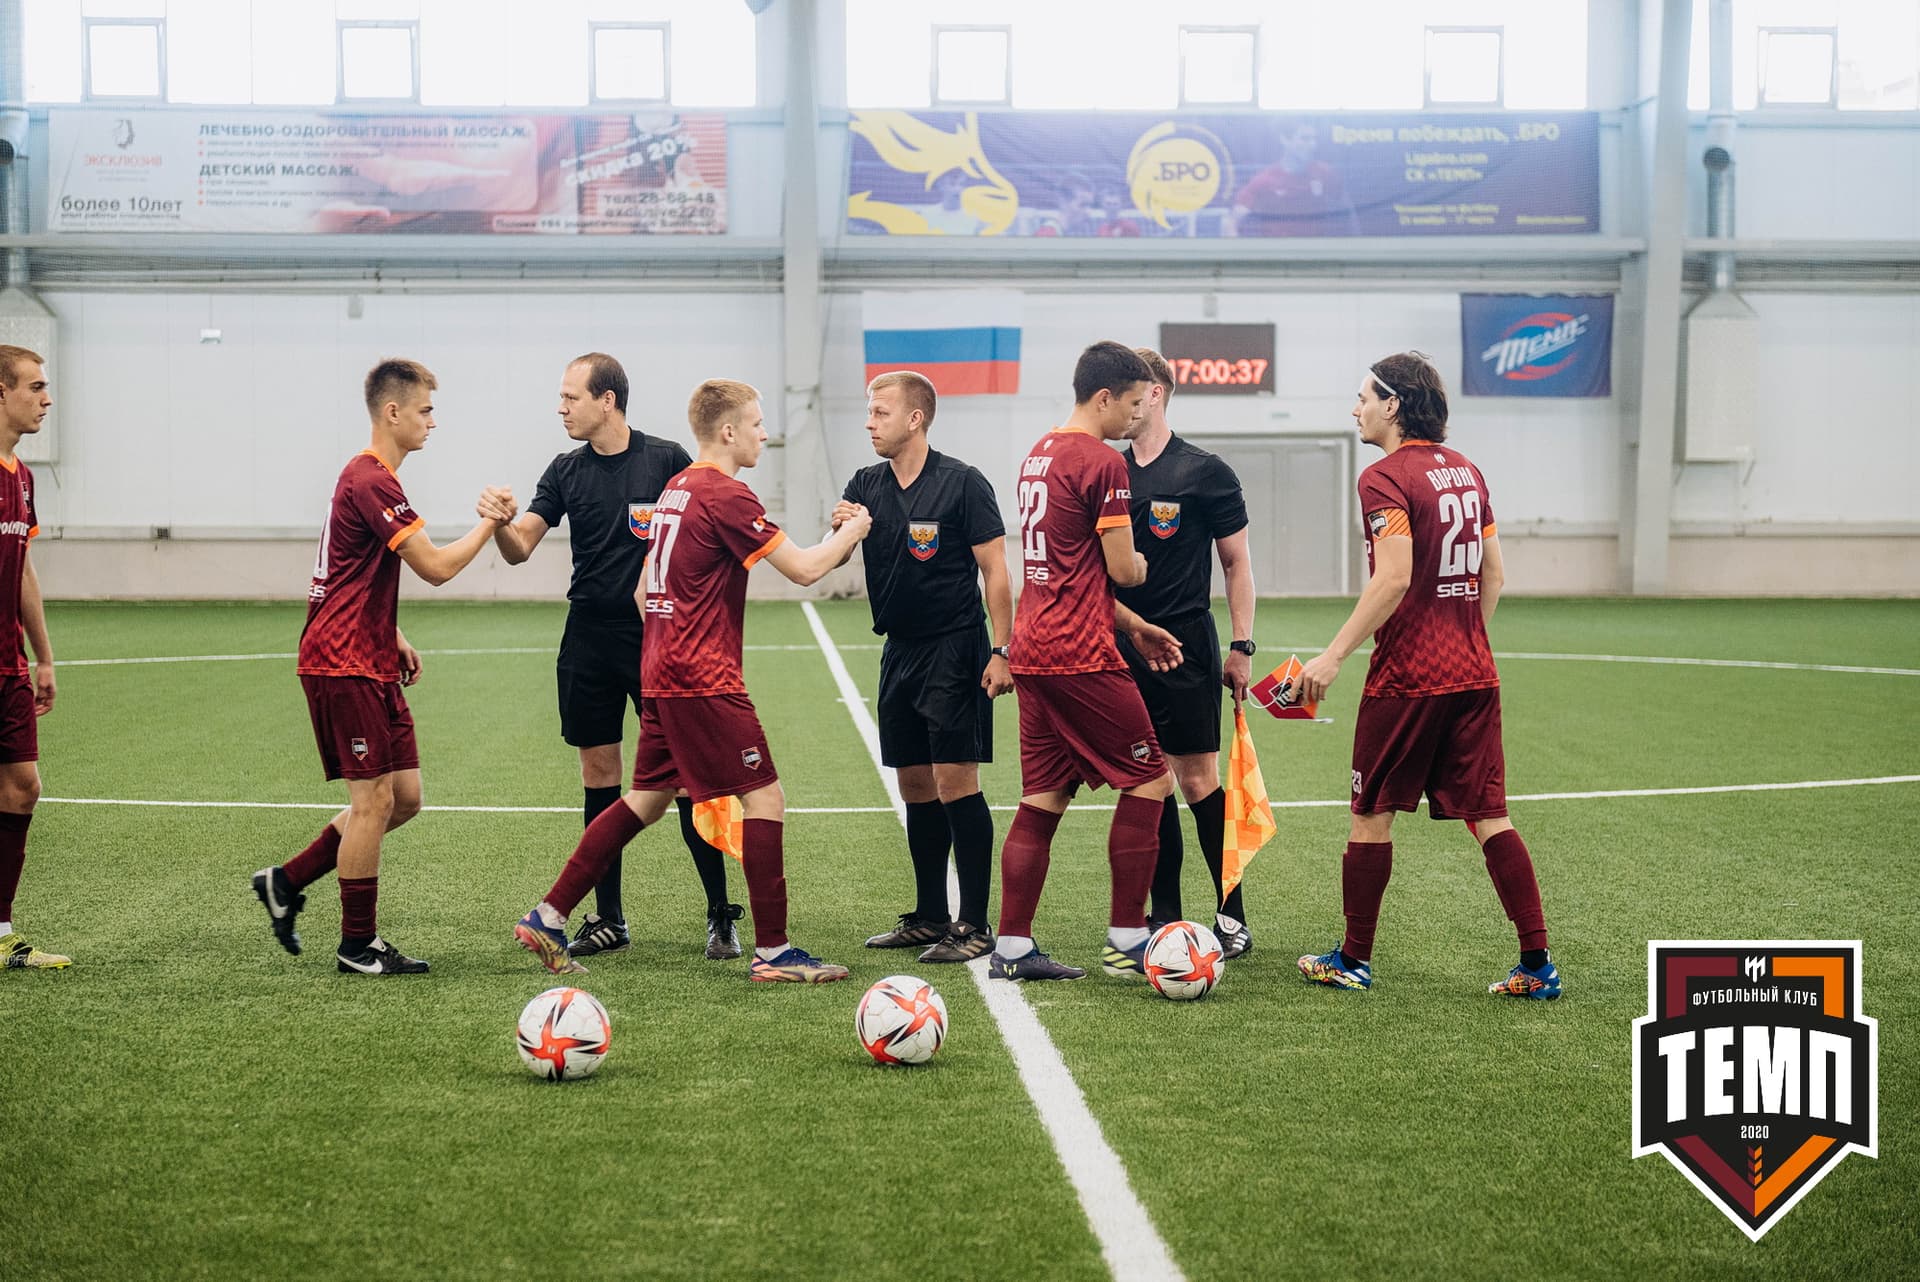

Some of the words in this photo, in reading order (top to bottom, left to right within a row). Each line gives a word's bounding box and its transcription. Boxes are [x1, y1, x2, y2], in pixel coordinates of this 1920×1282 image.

[61, 195, 120, 212] более
[199, 162, 277, 177] ДЕТСКИЙ
[645, 512, 682, 595] 27
[1019, 480, 1048, 562] 22
[1438, 490, 1484, 578] 23
